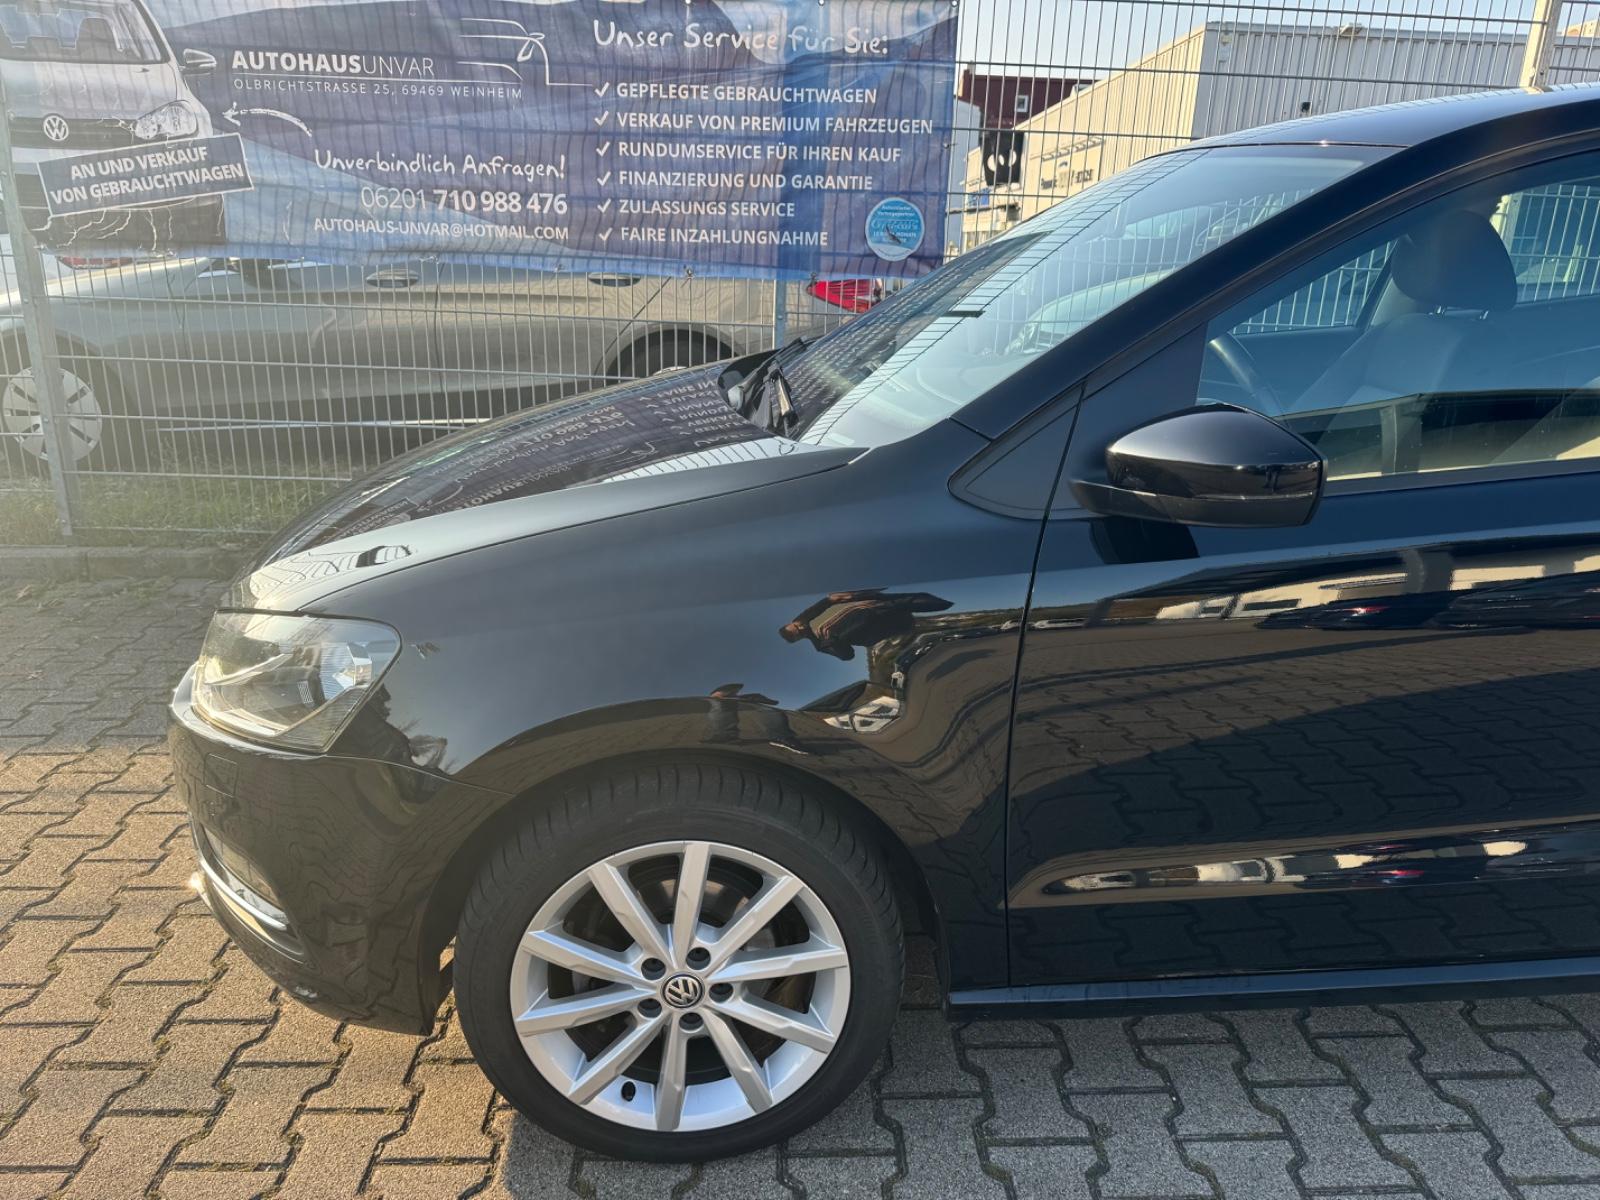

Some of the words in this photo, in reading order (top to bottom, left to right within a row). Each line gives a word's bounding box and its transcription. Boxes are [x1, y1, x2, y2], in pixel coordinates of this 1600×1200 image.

[593, 19, 674, 48] Unser
[683, 22, 778, 50] Service
[788, 25, 835, 52] für
[844, 27, 888, 55] Sie:
[233, 78, 367, 95] OLBRICHTSTRASSE
[373, 83, 395, 96] 25,
[401, 84, 444, 97] 69469
[450, 86, 522, 99] WEINHEIM
[616, 82, 709, 100] GEPFLEGTE
[713, 85, 877, 104] GEBRAUCHTWAGEN
[616, 111, 694, 129] VERKAUF
[698, 114, 735, 131] VON
[740, 115, 820, 133] PREMIUM
[825, 117, 933, 135] FAHRZEUGEN
[70, 162, 96, 181] AN
[97, 156, 135, 176] UND
[136, 146, 209, 170] VERKAUF
[618, 141, 762, 160] RUNDUMSERVICE
[766, 142, 799, 161] FÜR
[803, 145, 853, 162] IHREN
[857, 147, 902, 163] KAUF
[314, 149, 455, 175] Unverbindlich
[462, 154, 566, 182] Anfragen!
[50, 184, 89, 206] VON
[89, 162, 245, 199] GEBRAUCHTWAGEN
[619, 170, 745, 188] FINANZIERUNG
[750, 172, 787, 188] UND
[791, 174, 873, 191] GARANTIE
[360, 186, 426, 209] 06201
[432, 188, 477, 212] 710
[480, 190, 522, 213] 988
[526, 192, 569, 215] 476
[619, 199, 727, 216] ZULASSUNGS
[731, 201, 795, 218] SERVICE
[314, 217, 569, 241] AUTOHAUS-UNVAR@HOTMAIL.COM
[620, 226, 667, 243] FAIRE
[670, 228, 829, 246] INZAHLUNGNAHME
